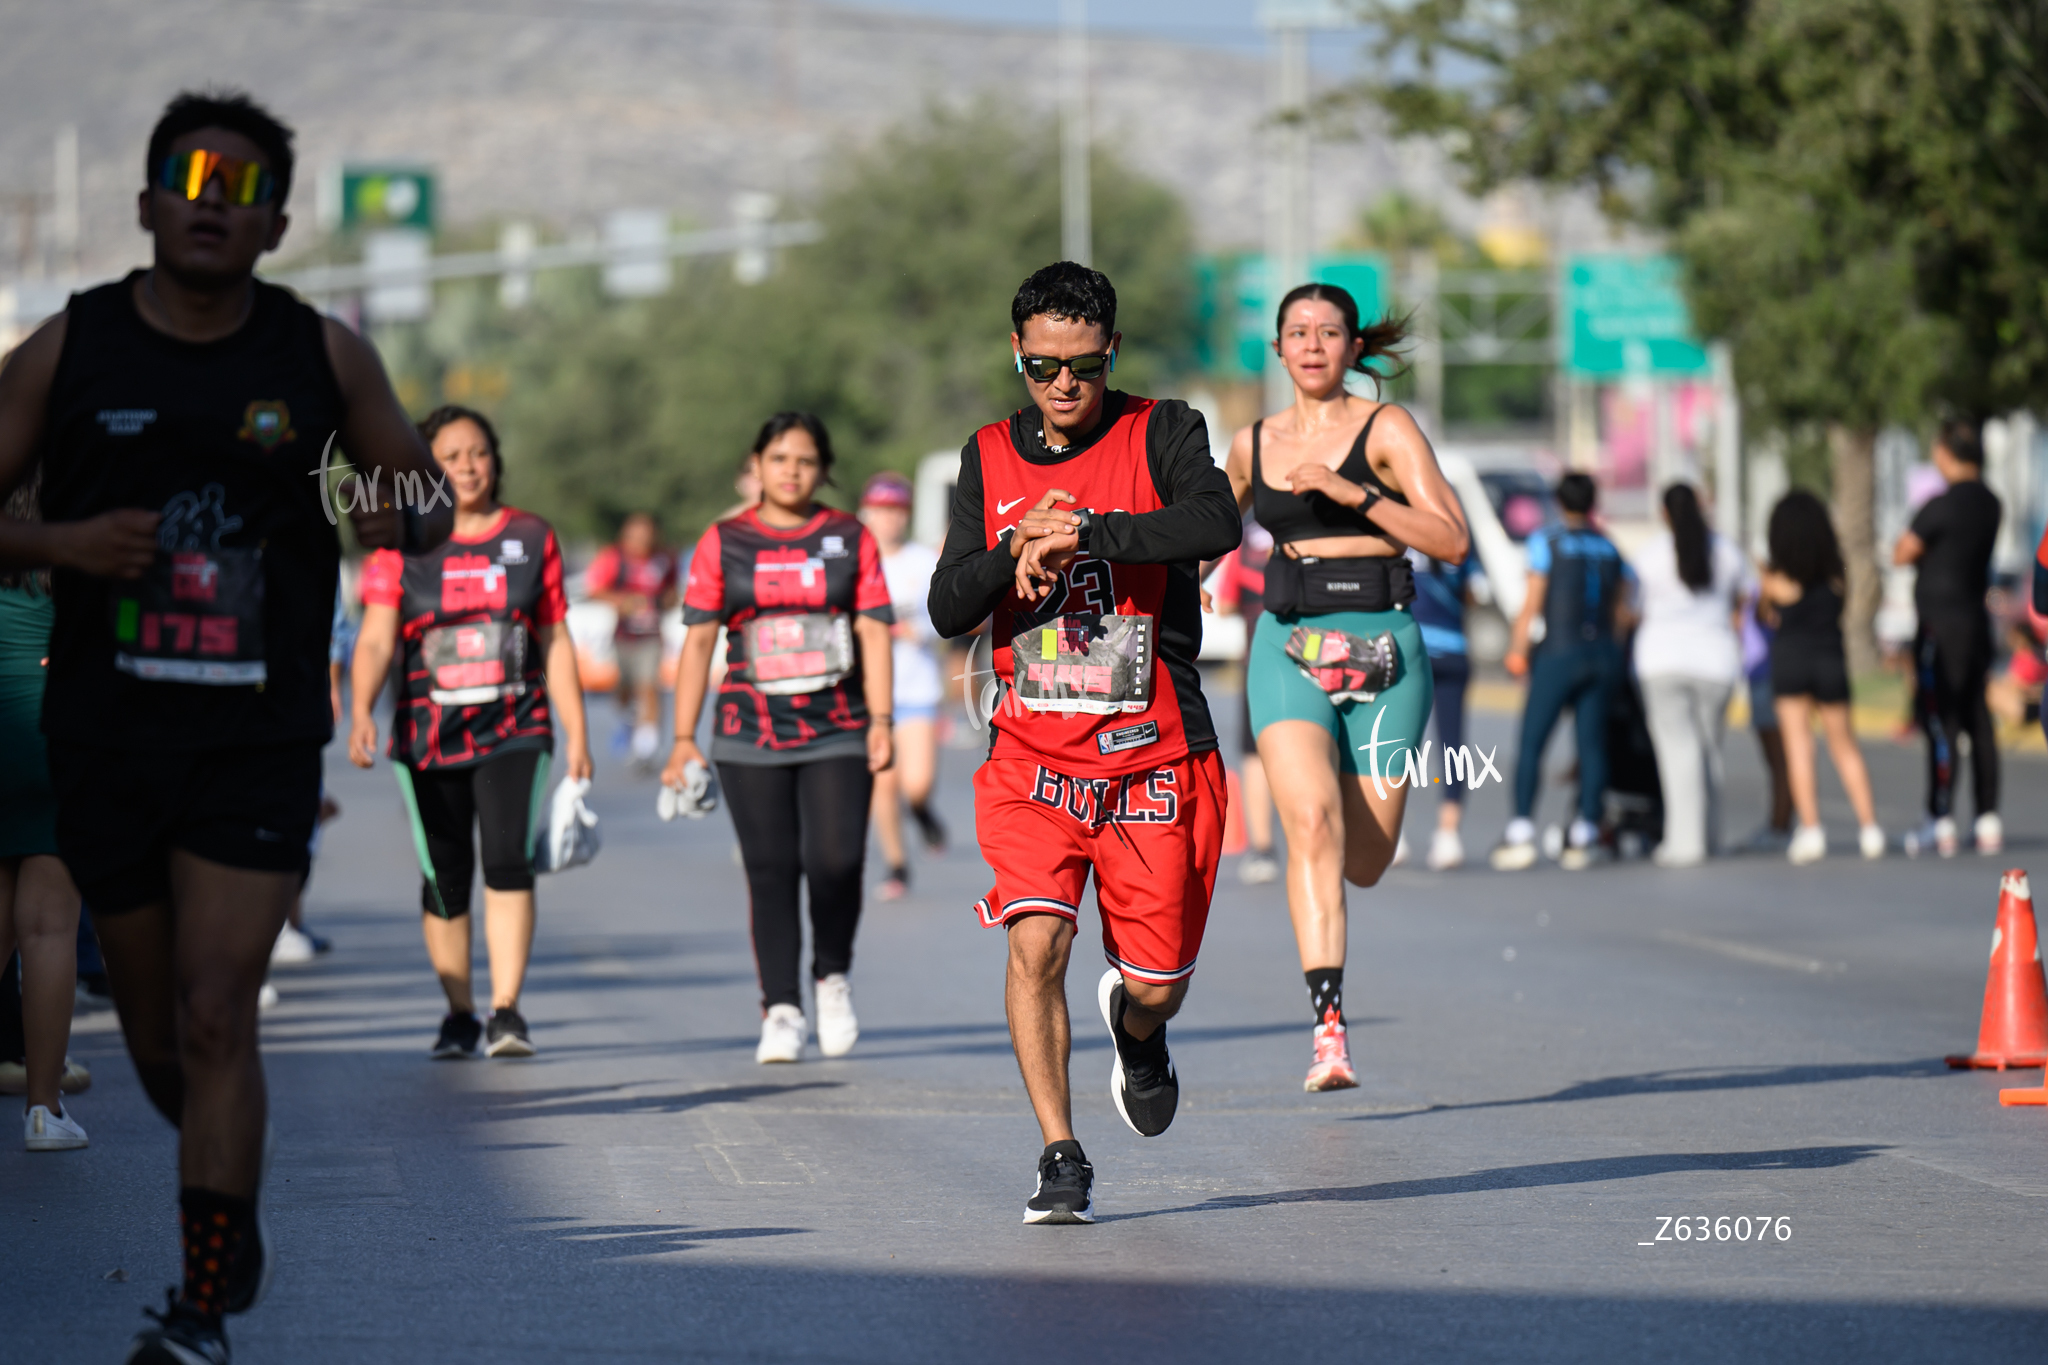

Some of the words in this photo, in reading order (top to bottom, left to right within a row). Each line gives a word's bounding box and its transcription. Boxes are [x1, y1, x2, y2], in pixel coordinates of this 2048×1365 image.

[1326, 582, 1361, 591] KIPRUN
[141, 613, 239, 655] 175
[1027, 663, 1113, 694] 445
[1134, 624, 1146, 695] MEDALLA
[1029, 765, 1178, 829] BULLS
